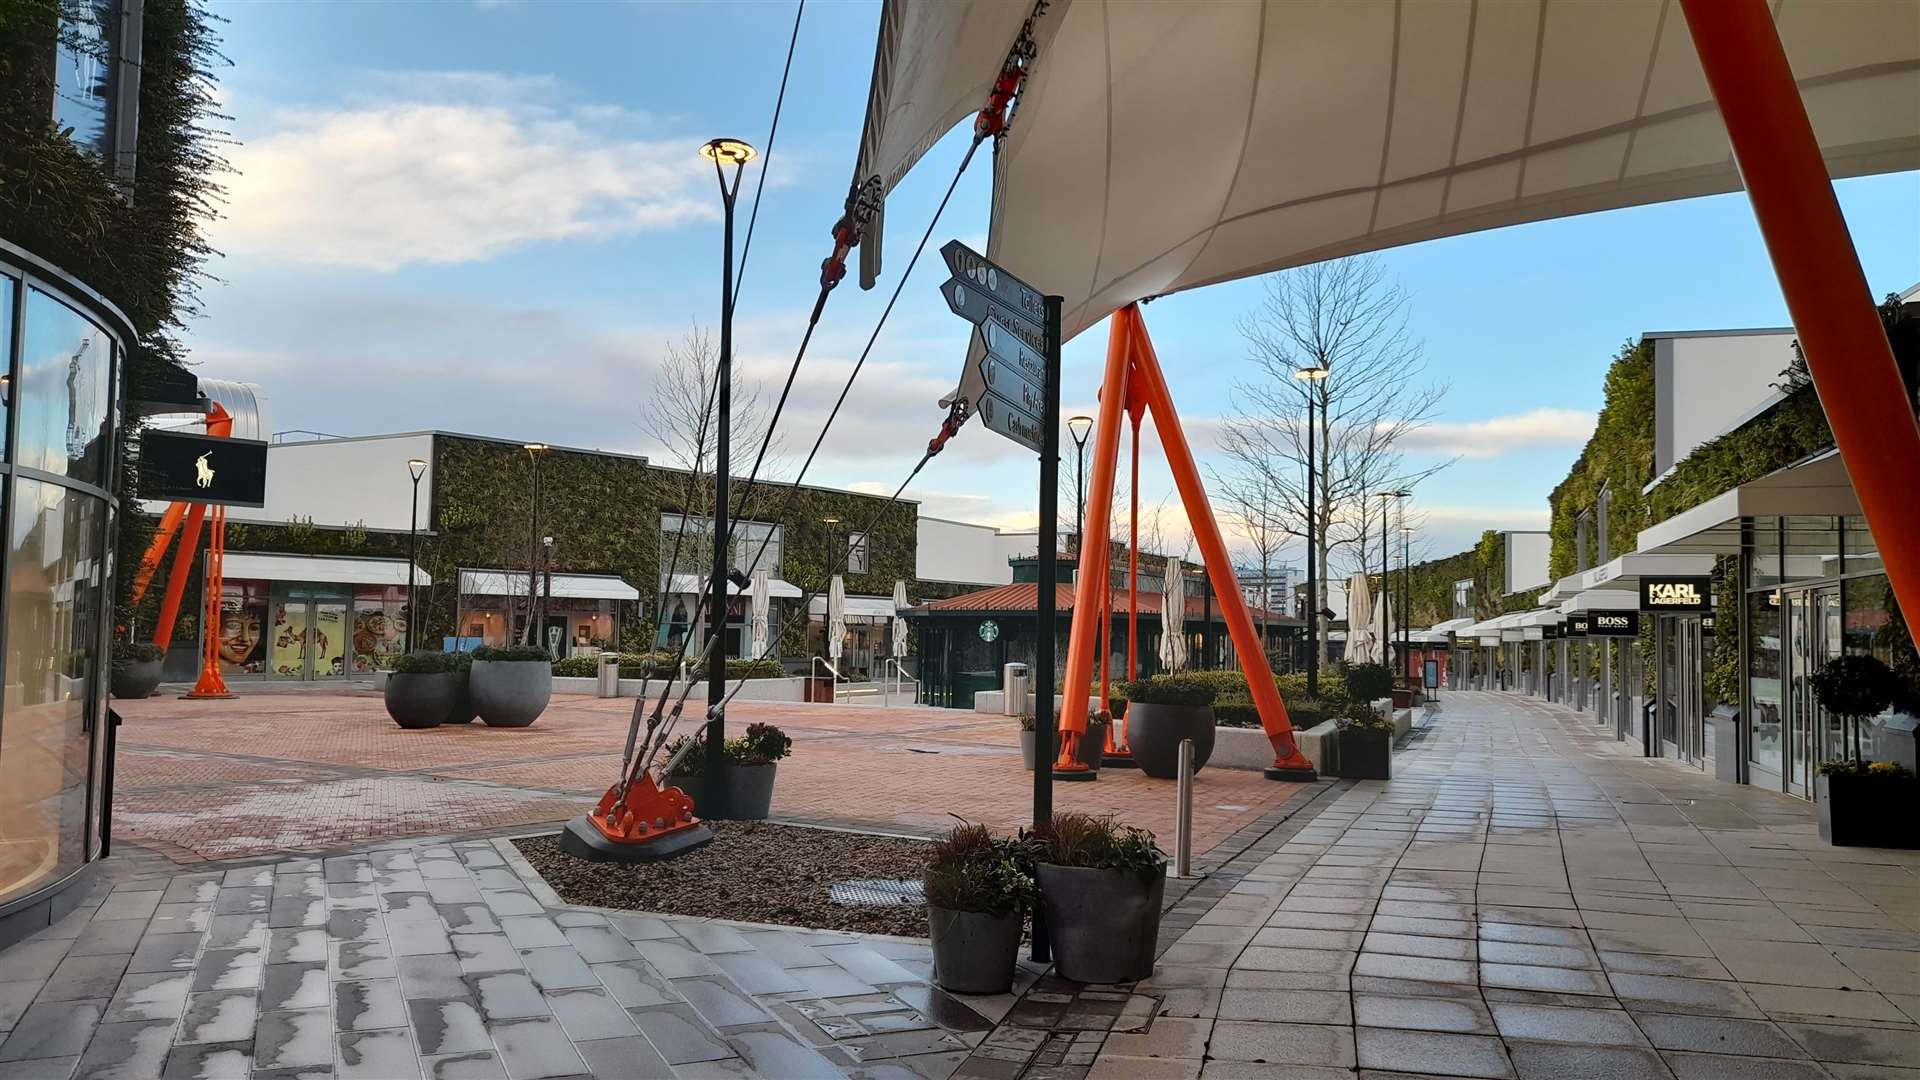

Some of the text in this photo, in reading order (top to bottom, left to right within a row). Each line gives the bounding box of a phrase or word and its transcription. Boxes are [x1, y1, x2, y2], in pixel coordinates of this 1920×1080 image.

[1019, 287, 1045, 320] Toilets
[1013, 318, 1044, 352] Services
[1649, 584, 1701, 598] KARL
[1649, 597, 1701, 605] LAGERFELD
[1597, 616, 1628, 626] BOSS
